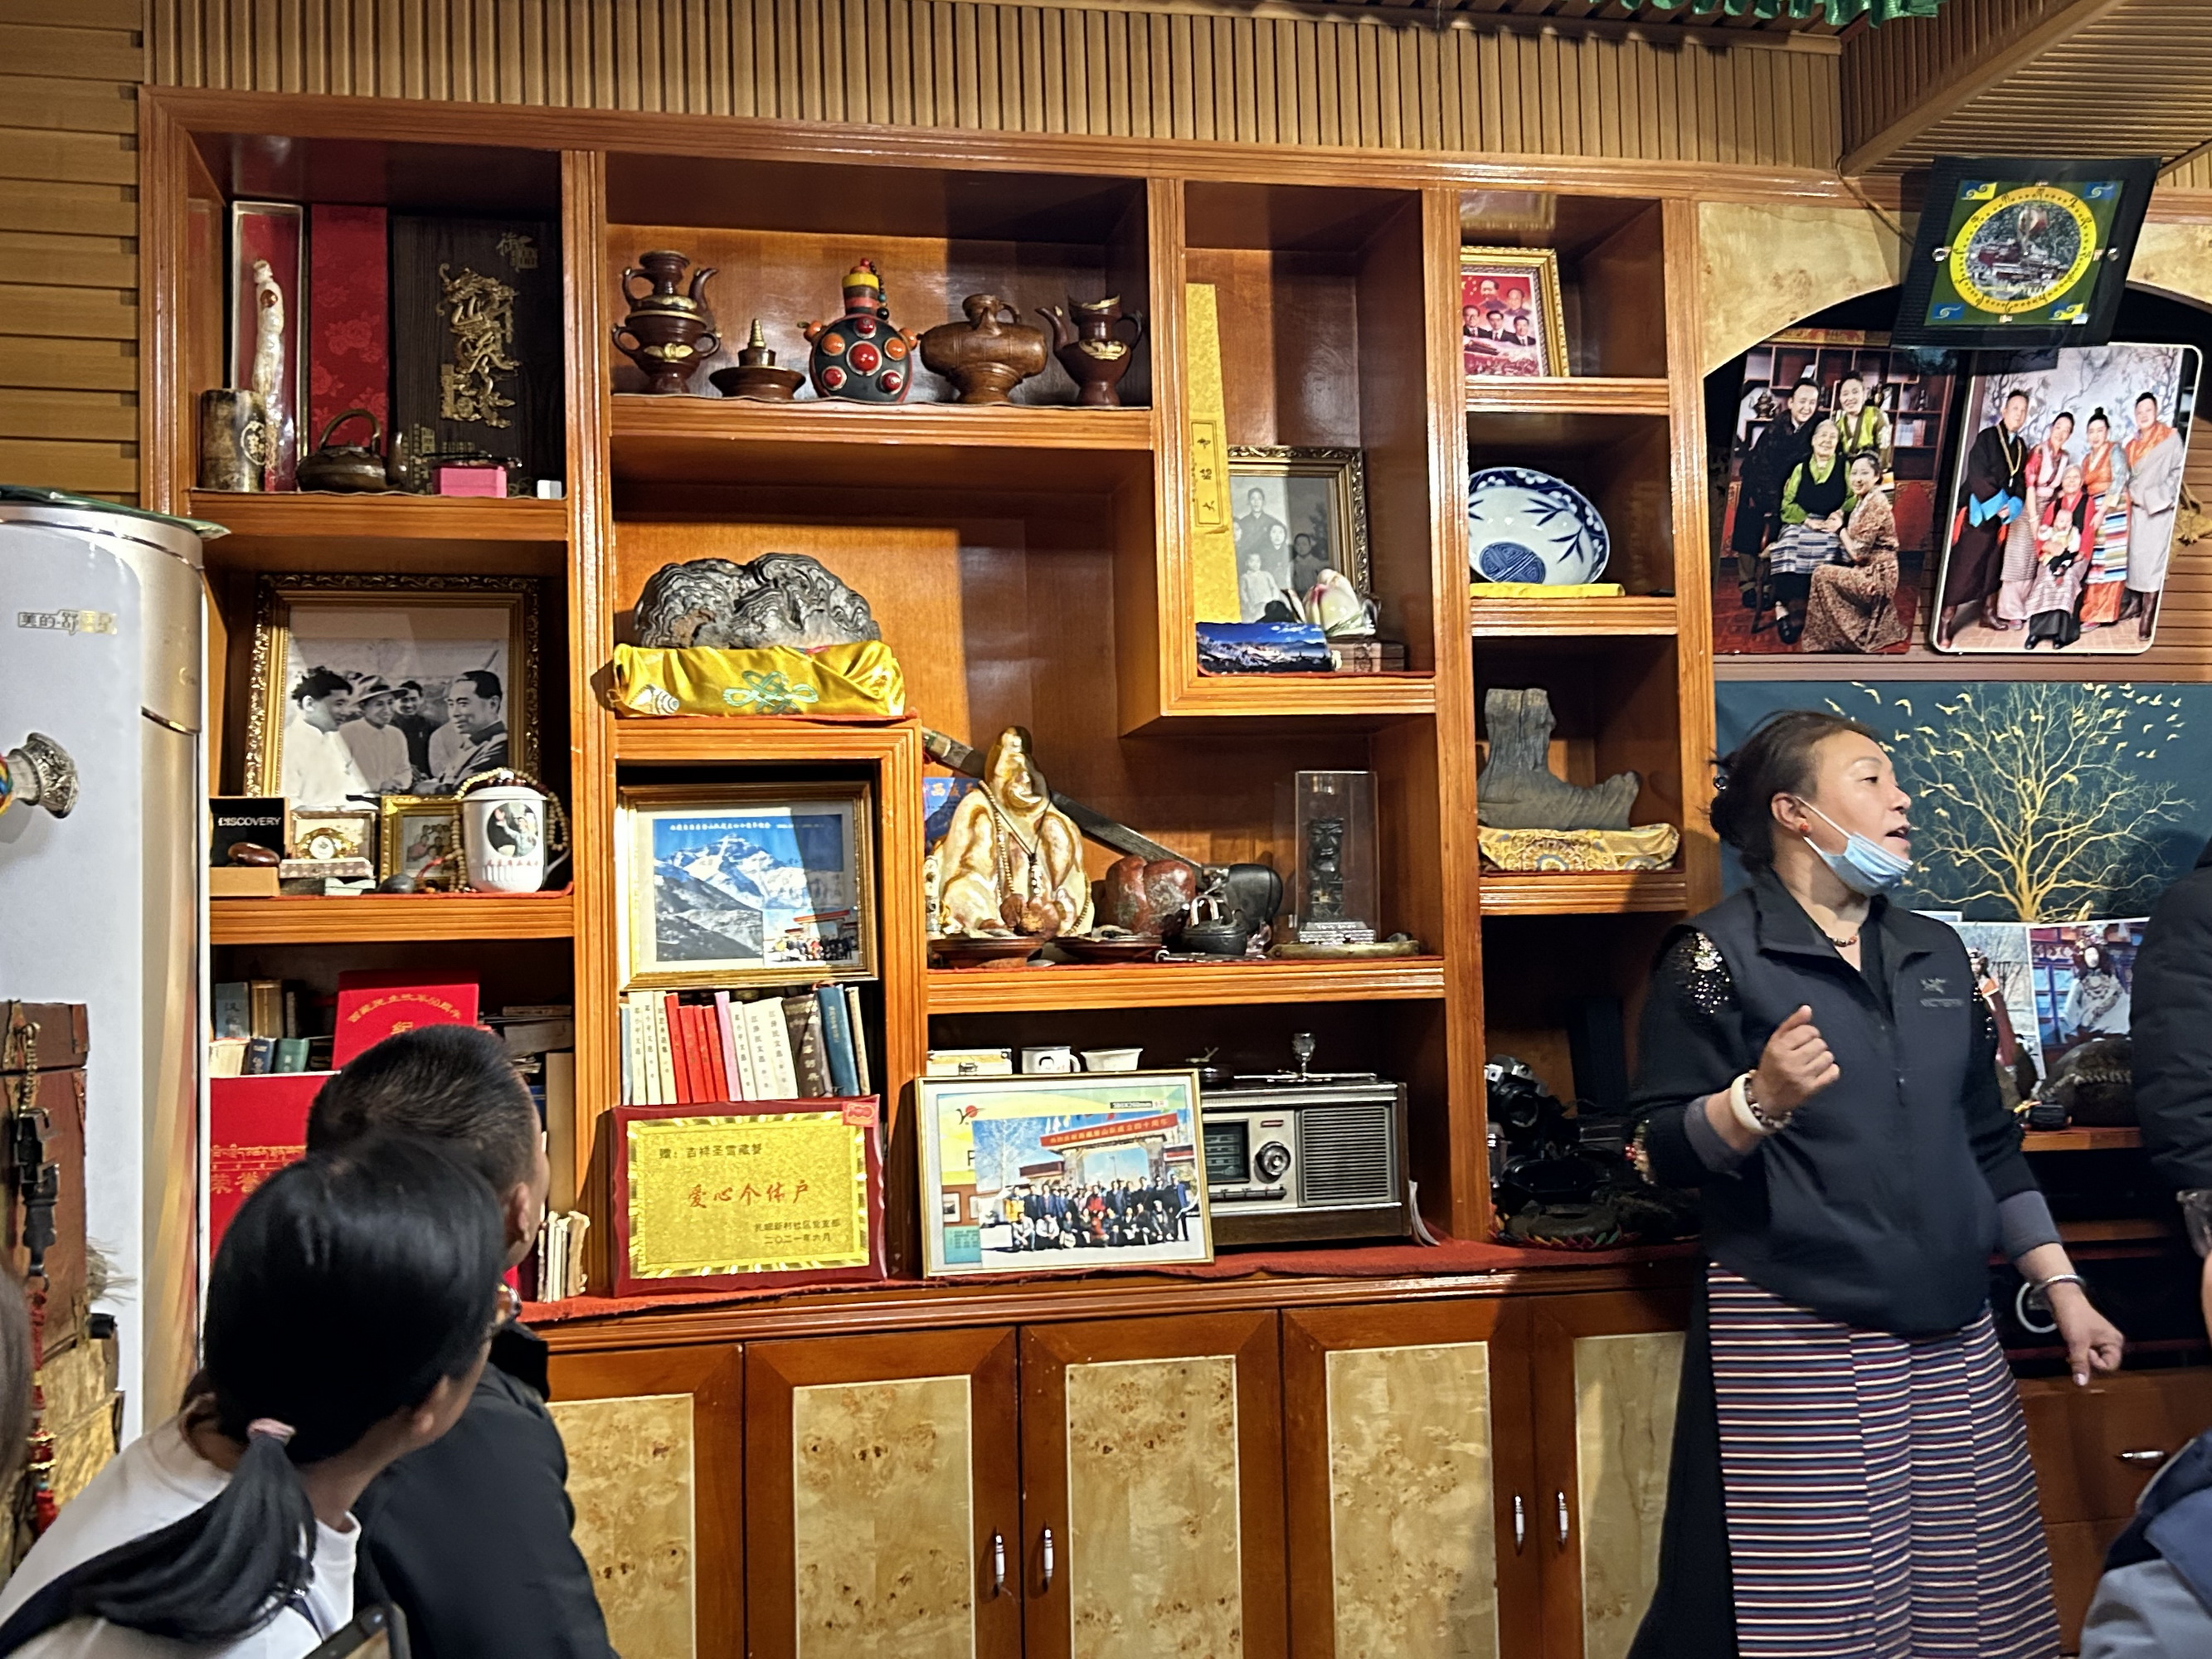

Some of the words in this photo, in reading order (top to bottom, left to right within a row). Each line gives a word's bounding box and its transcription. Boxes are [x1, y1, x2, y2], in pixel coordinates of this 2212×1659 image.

[218, 816, 282, 827] DISCOVERY
[688, 1179, 809, 1209] 爱心个体户
